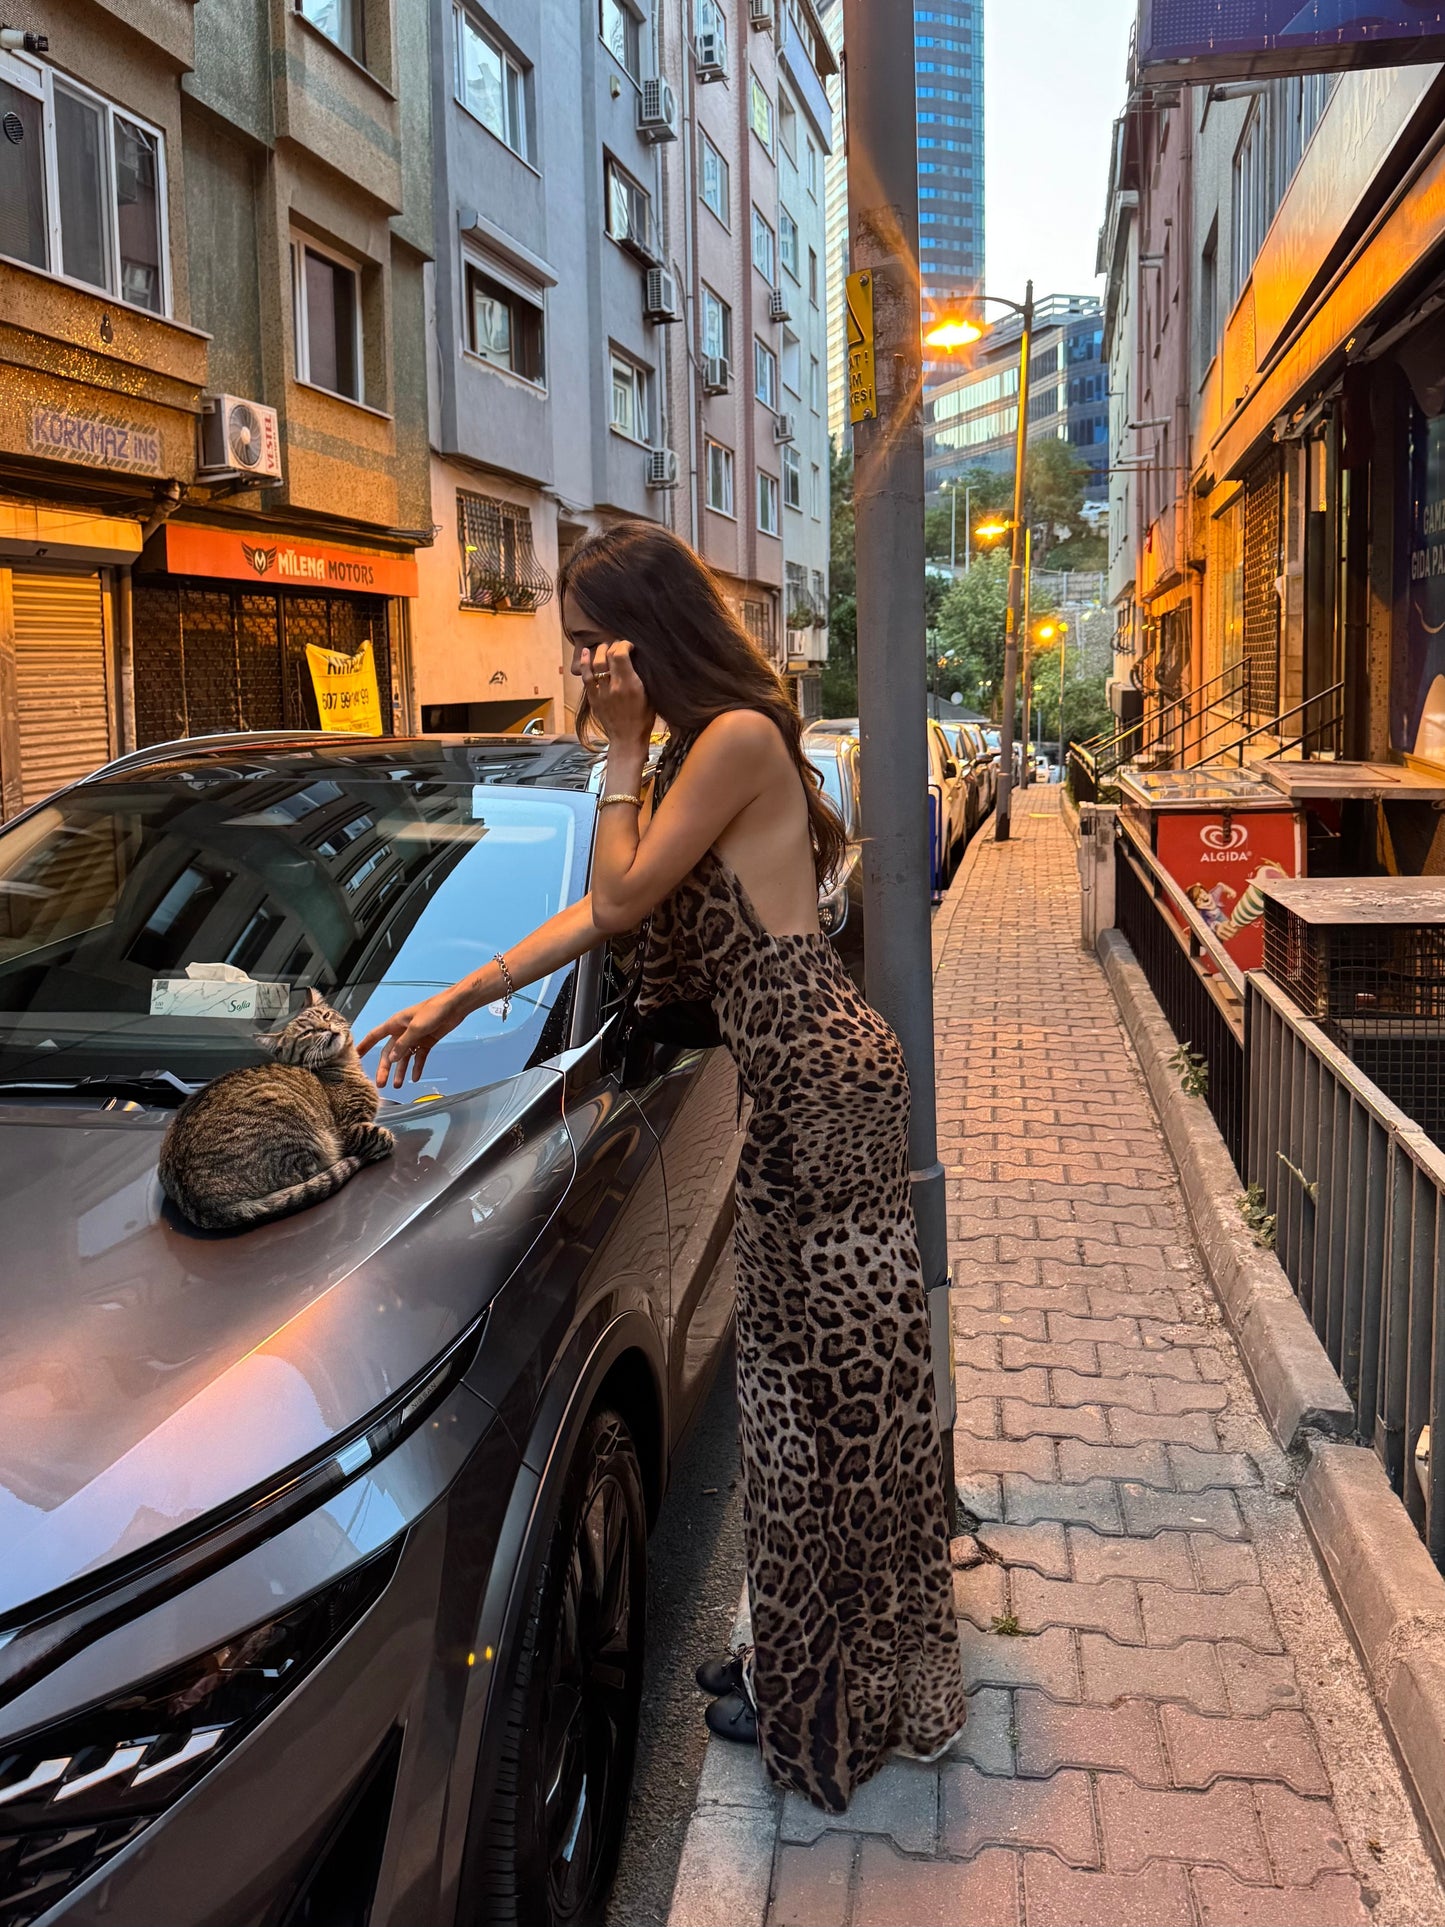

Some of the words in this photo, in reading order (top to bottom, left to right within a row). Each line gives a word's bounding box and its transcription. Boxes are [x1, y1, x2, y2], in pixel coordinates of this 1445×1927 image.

[1343, 71, 1398, 168] PAZA
[34, 411, 128, 459] KORKMAZ
[265, 415, 275, 469] VESTEL
[328, 560, 374, 585] MOTORS
[1432, 543, 1445, 576] PA
[411, 1382, 437, 1410] NISSAN
